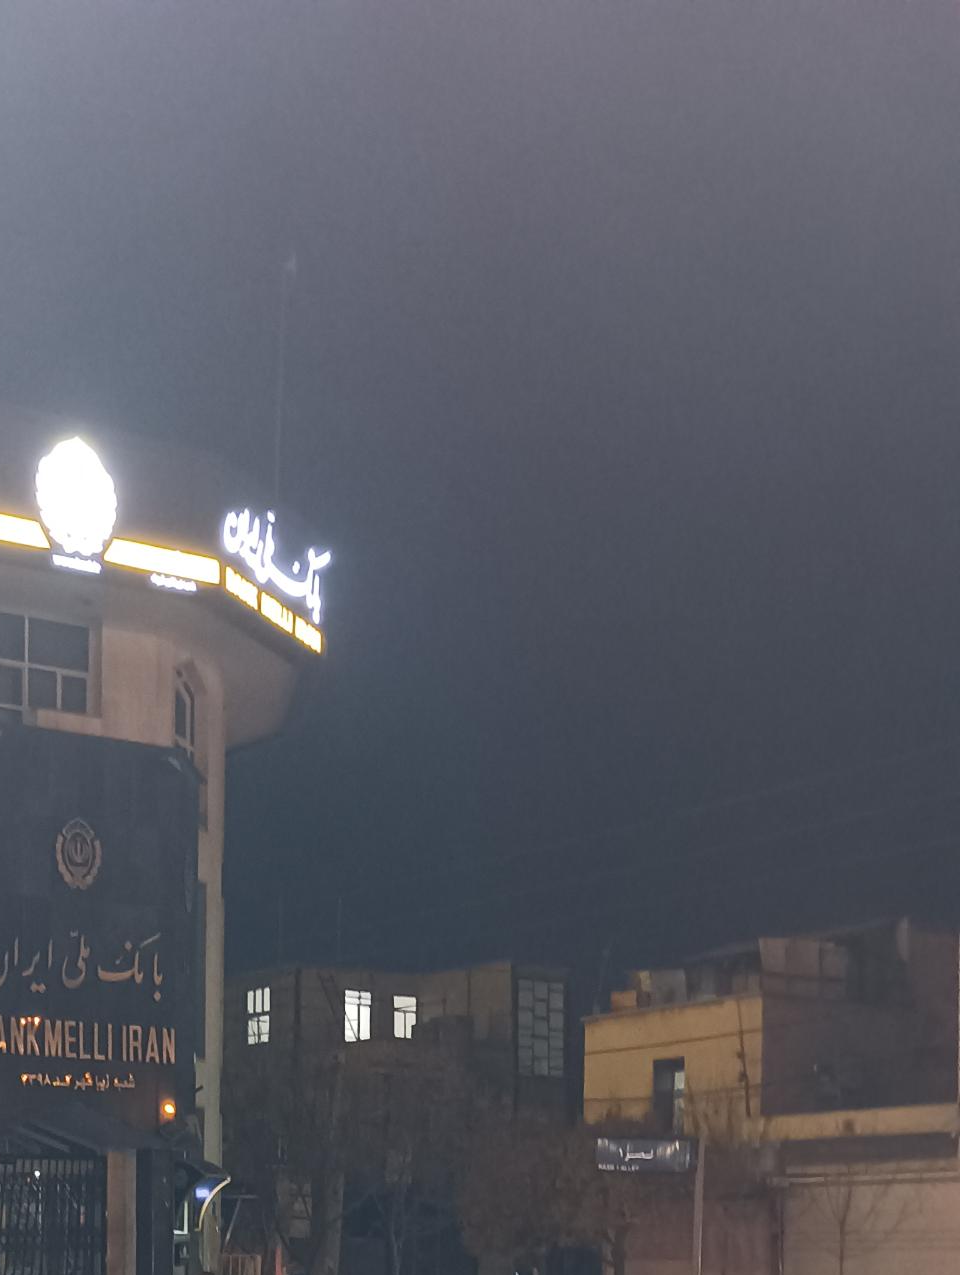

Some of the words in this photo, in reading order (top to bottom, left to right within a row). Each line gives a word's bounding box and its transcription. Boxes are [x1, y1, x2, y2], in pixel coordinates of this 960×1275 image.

[98, 932, 164, 1002] بانک
[43, 1017, 113, 1062] MELLI
[121, 1024, 176, 1066] IRAN
